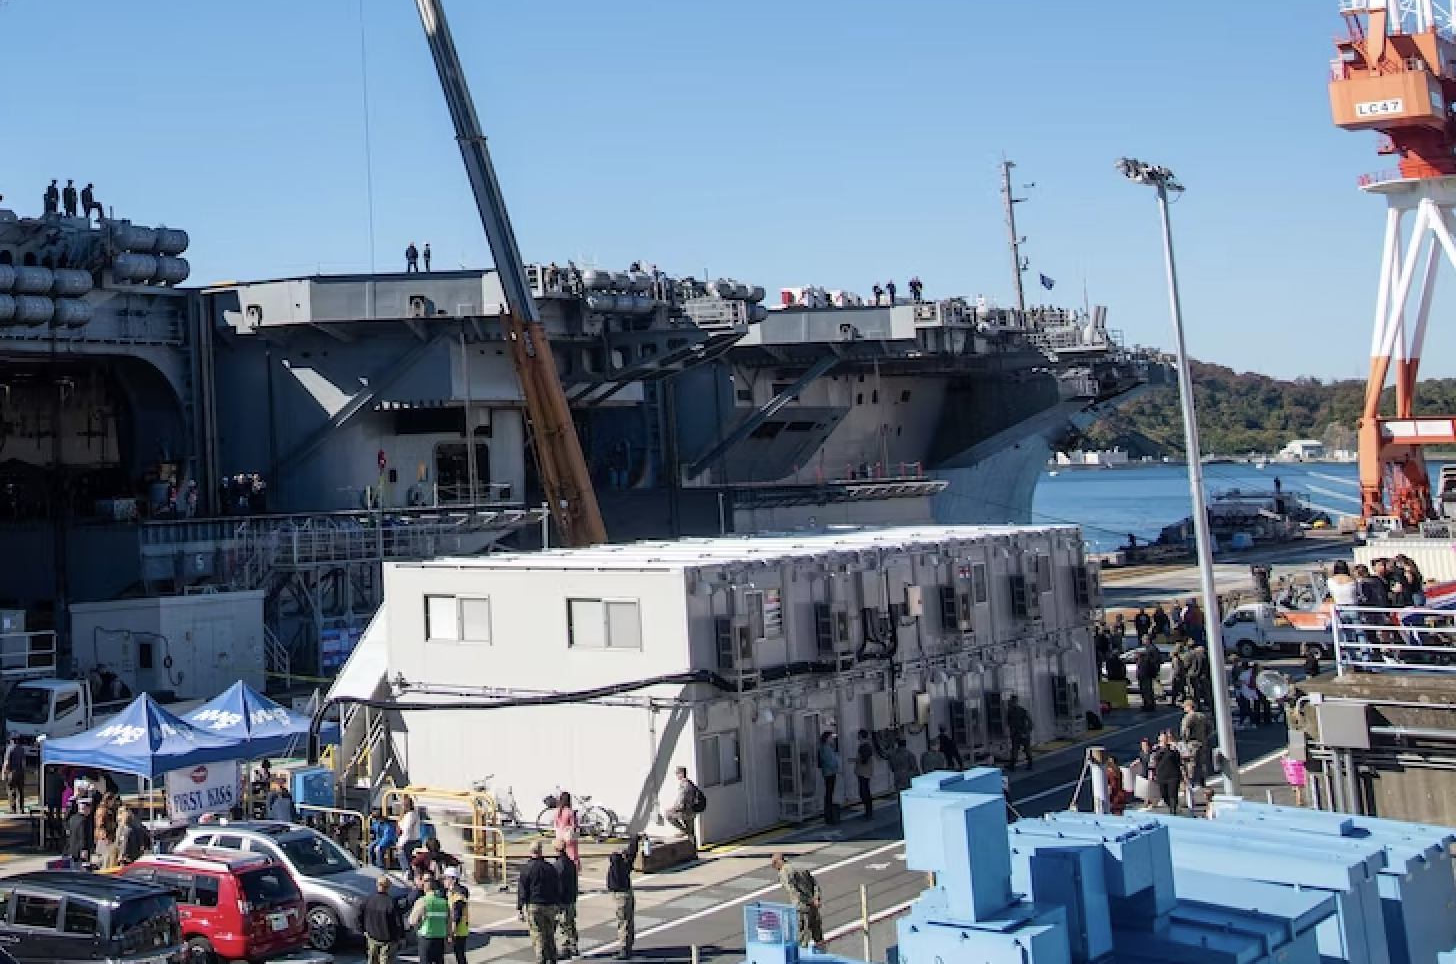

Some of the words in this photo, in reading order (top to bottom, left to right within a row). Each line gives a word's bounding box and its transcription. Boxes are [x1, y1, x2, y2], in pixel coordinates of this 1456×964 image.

[1357, 101, 1399, 115] LC47
[173, 790, 203, 813] FIRST
[207, 784, 233, 807] KISS
